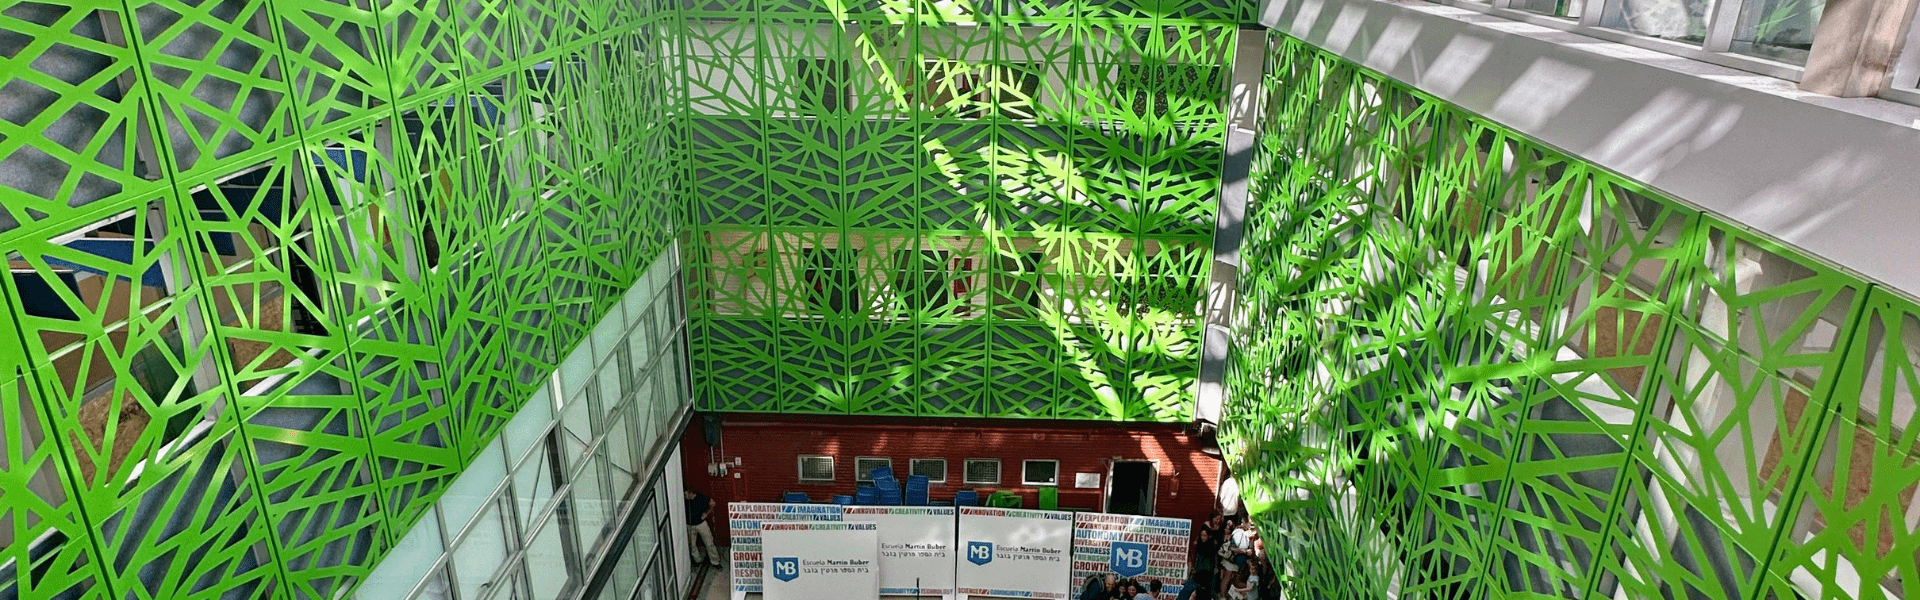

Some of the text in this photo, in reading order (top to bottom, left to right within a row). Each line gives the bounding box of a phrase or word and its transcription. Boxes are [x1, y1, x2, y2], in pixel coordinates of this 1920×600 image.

[797, 506, 840, 514] IMAGINATION
[972, 509, 1006, 517] INNOVATION
[1012, 511, 1043, 519] CREATIVITY
[1084, 513, 1190, 529] EXPLORATION IMAGINATION
[1086, 522, 1122, 531] INNOVATION
[1128, 526, 1161, 534] CREATIVITY
[1076, 530, 1189, 545] AUTONOMY TECHNOLOGY
[970, 544, 990, 559] MB
[1079, 546, 1110, 554] KINDNESS
[1161, 545, 1188, 553] SCIENCE
[1074, 554, 1110, 562] FRIENDSHIP
[1115, 547, 1143, 568] MB
[1149, 552, 1186, 560] TEAMWORK
[776, 560, 796, 575] MB
[1073, 561, 1110, 571] GROWTH
[1159, 560, 1186, 568] IDENTITY
[1147, 567, 1185, 578] RESPECT
